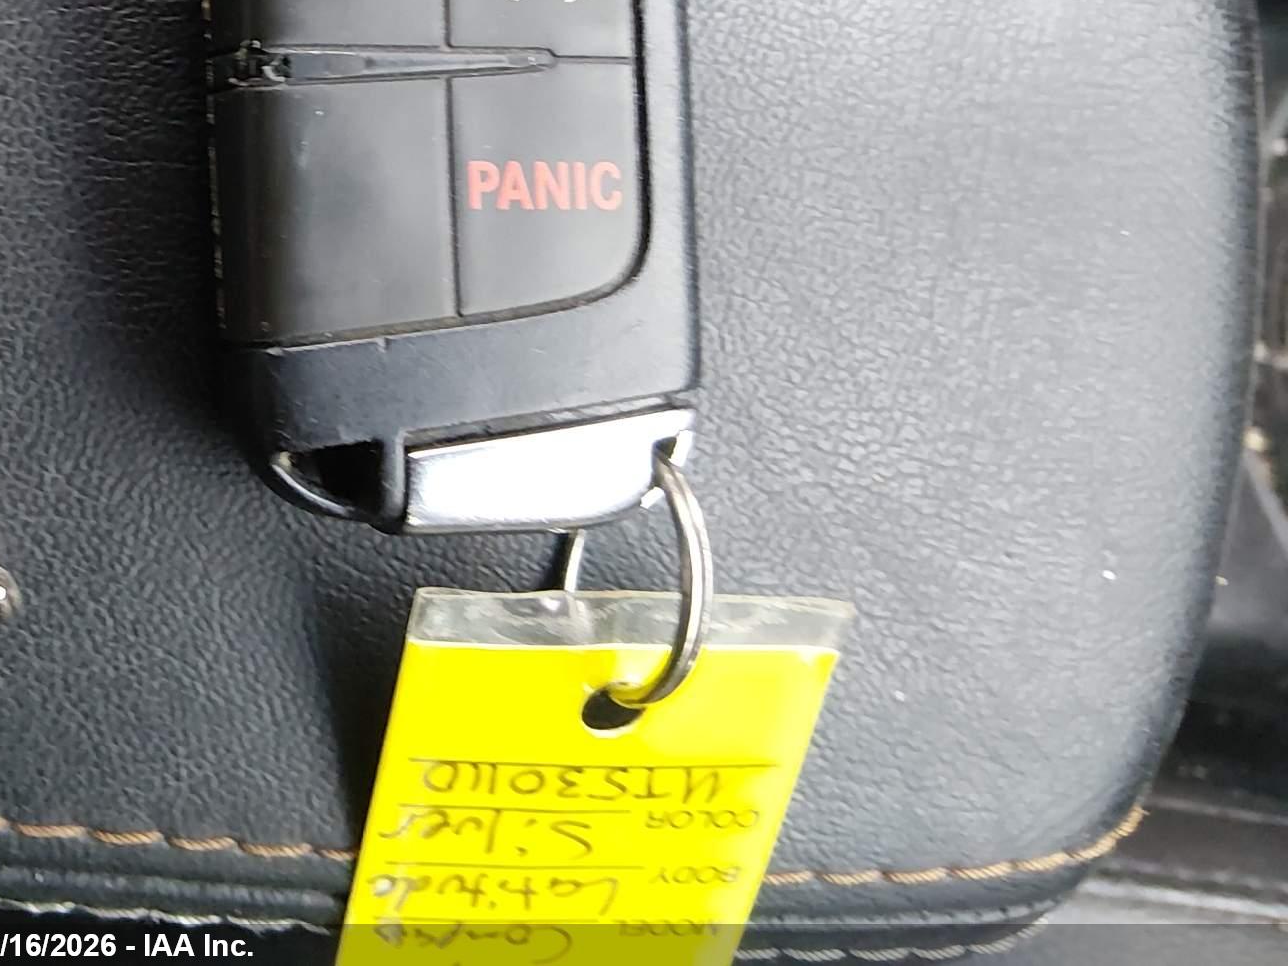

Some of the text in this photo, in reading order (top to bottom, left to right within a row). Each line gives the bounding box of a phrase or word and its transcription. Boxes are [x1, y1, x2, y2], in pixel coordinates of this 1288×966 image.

[466, 159, 622, 211] PANIC
[378, 809, 593, 860] Silver
[646, 810, 760, 830] COLOR
[649, 866, 741, 885] BODY
[367, 874, 619, 916] Latitude
[612, 919, 719, 937] MODEL
